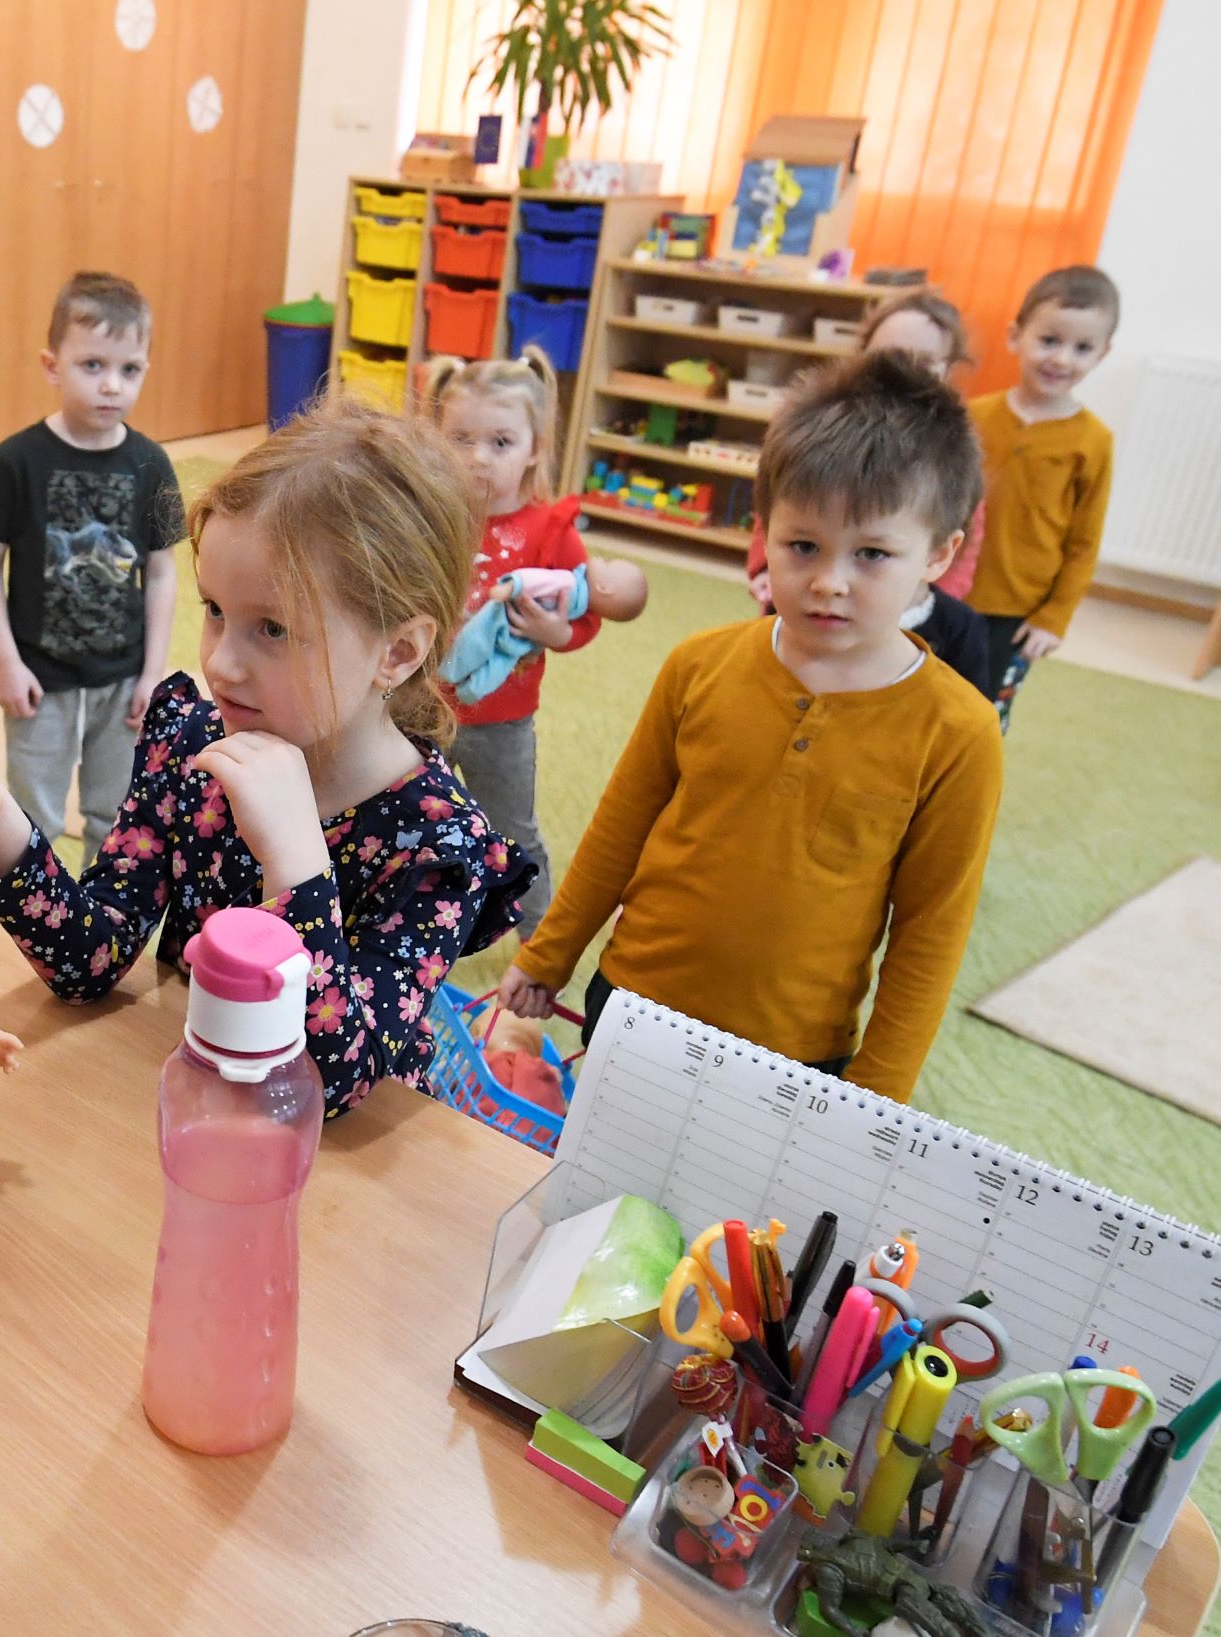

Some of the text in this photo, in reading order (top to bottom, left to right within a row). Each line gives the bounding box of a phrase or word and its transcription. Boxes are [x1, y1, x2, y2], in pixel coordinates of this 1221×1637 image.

[624, 1016, 636, 1030] 8
[713, 1054, 725, 1068] 9
[807, 1095, 829, 1115] 10
[908, 1138, 929, 1159] 11
[1016, 1183, 1041, 1207] 12
[1129, 1235, 1155, 1257] 13
[1086, 1333, 1110, 1355] 14
